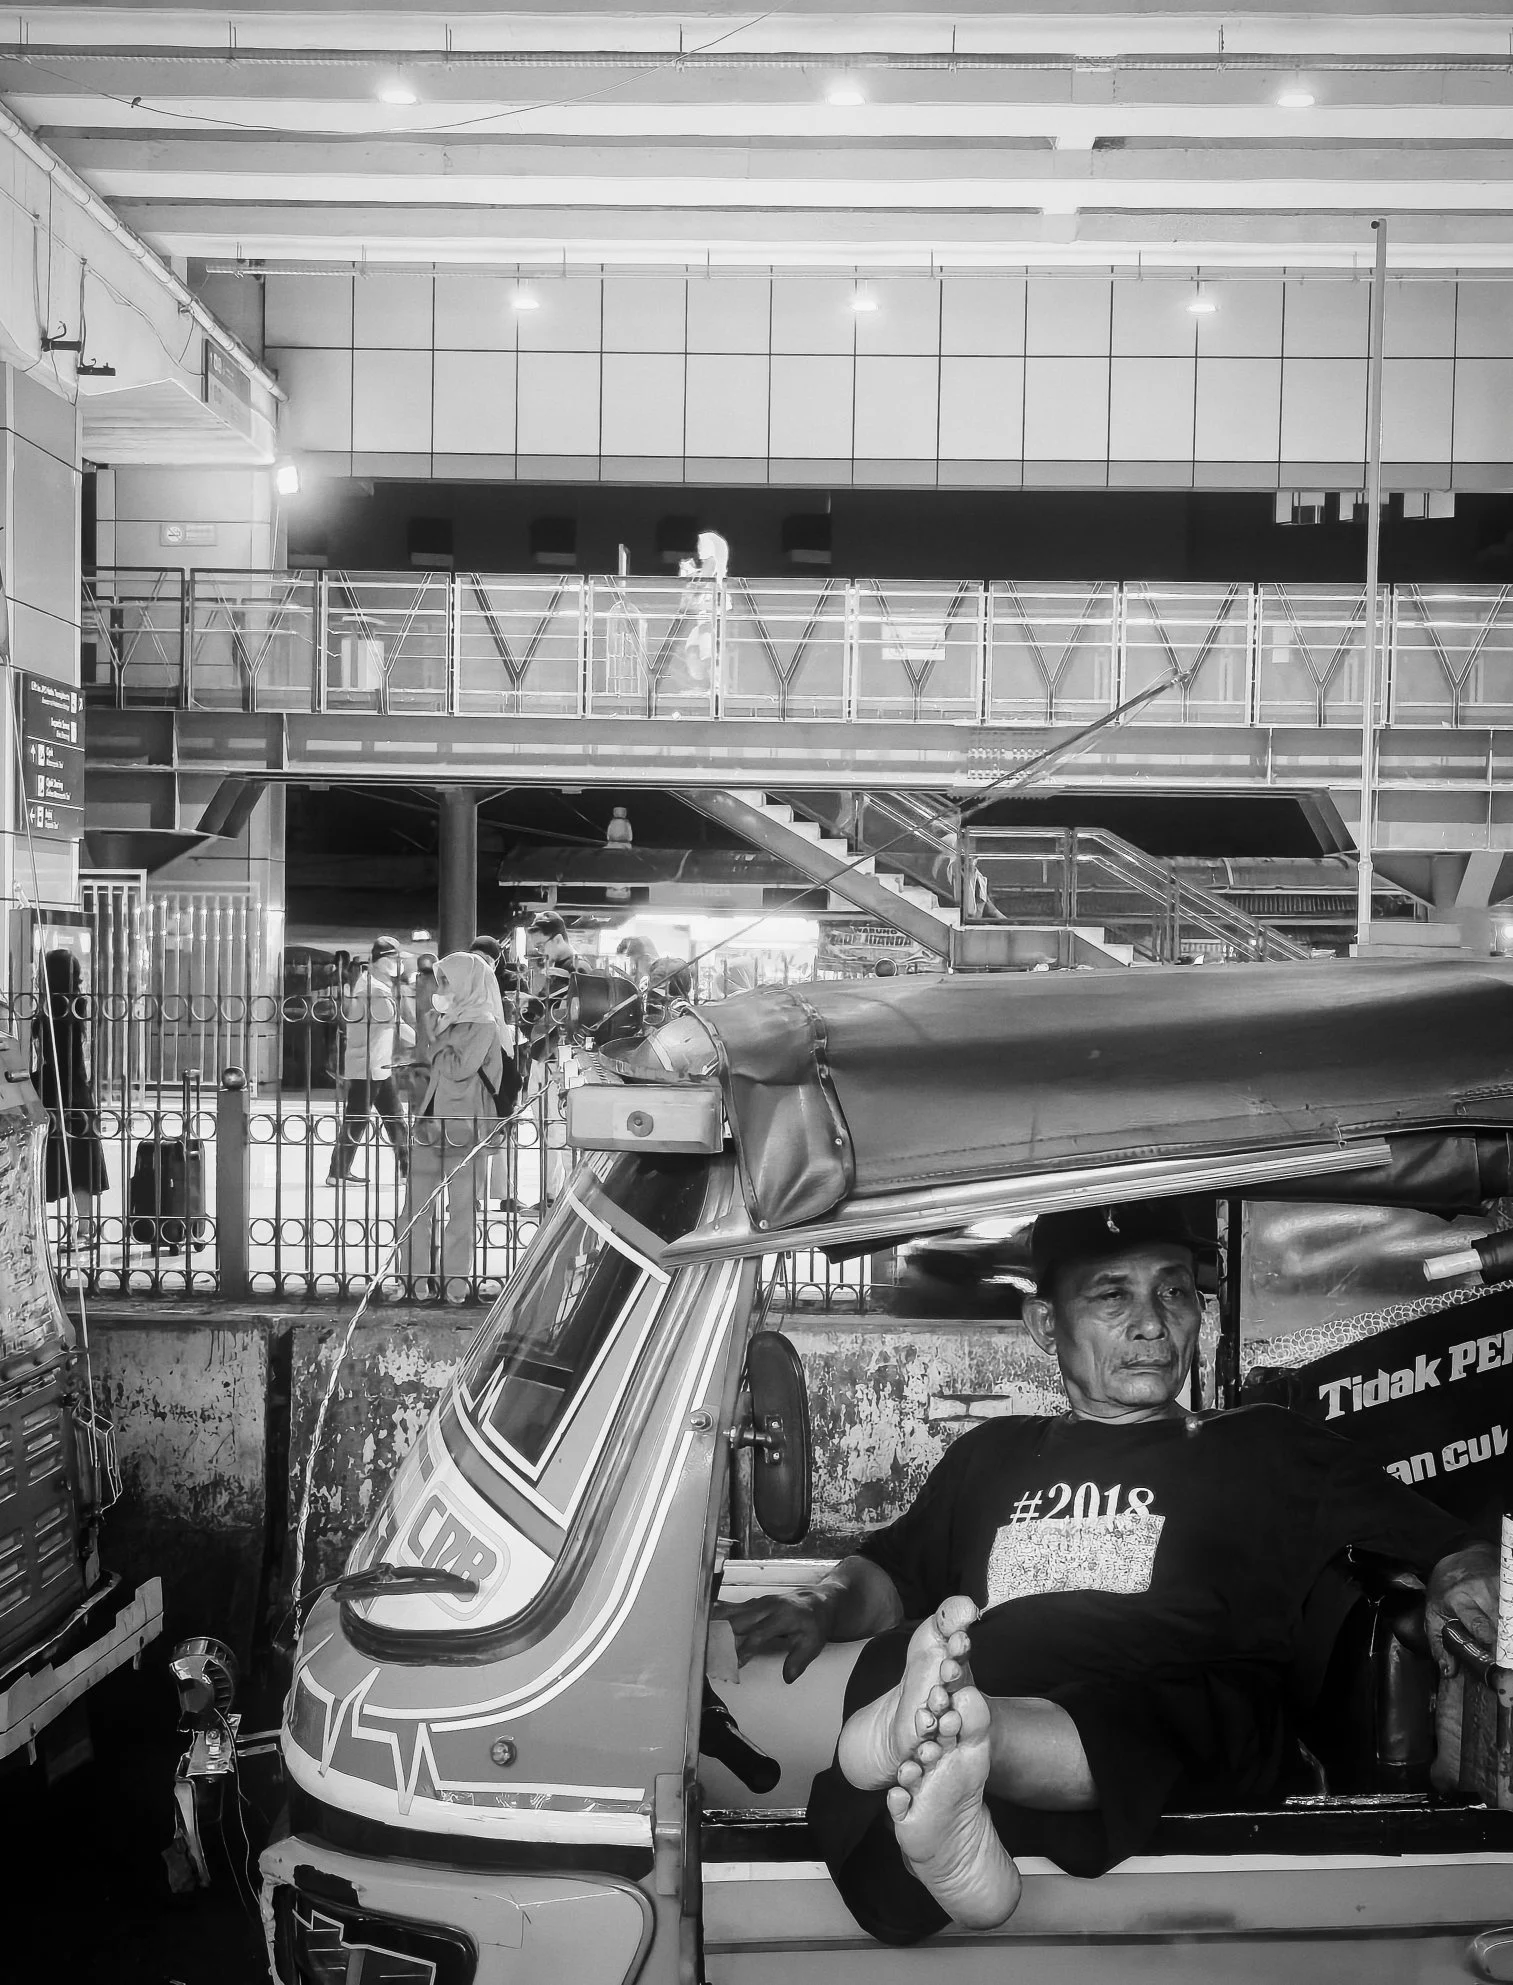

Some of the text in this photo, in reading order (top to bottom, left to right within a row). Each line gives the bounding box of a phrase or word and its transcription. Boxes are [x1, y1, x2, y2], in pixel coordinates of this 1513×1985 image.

[1319, 1354, 1442, 1421] Tidak
[1383, 1451, 1437, 1485] an
[1009, 1481, 1155, 1523] #2018
